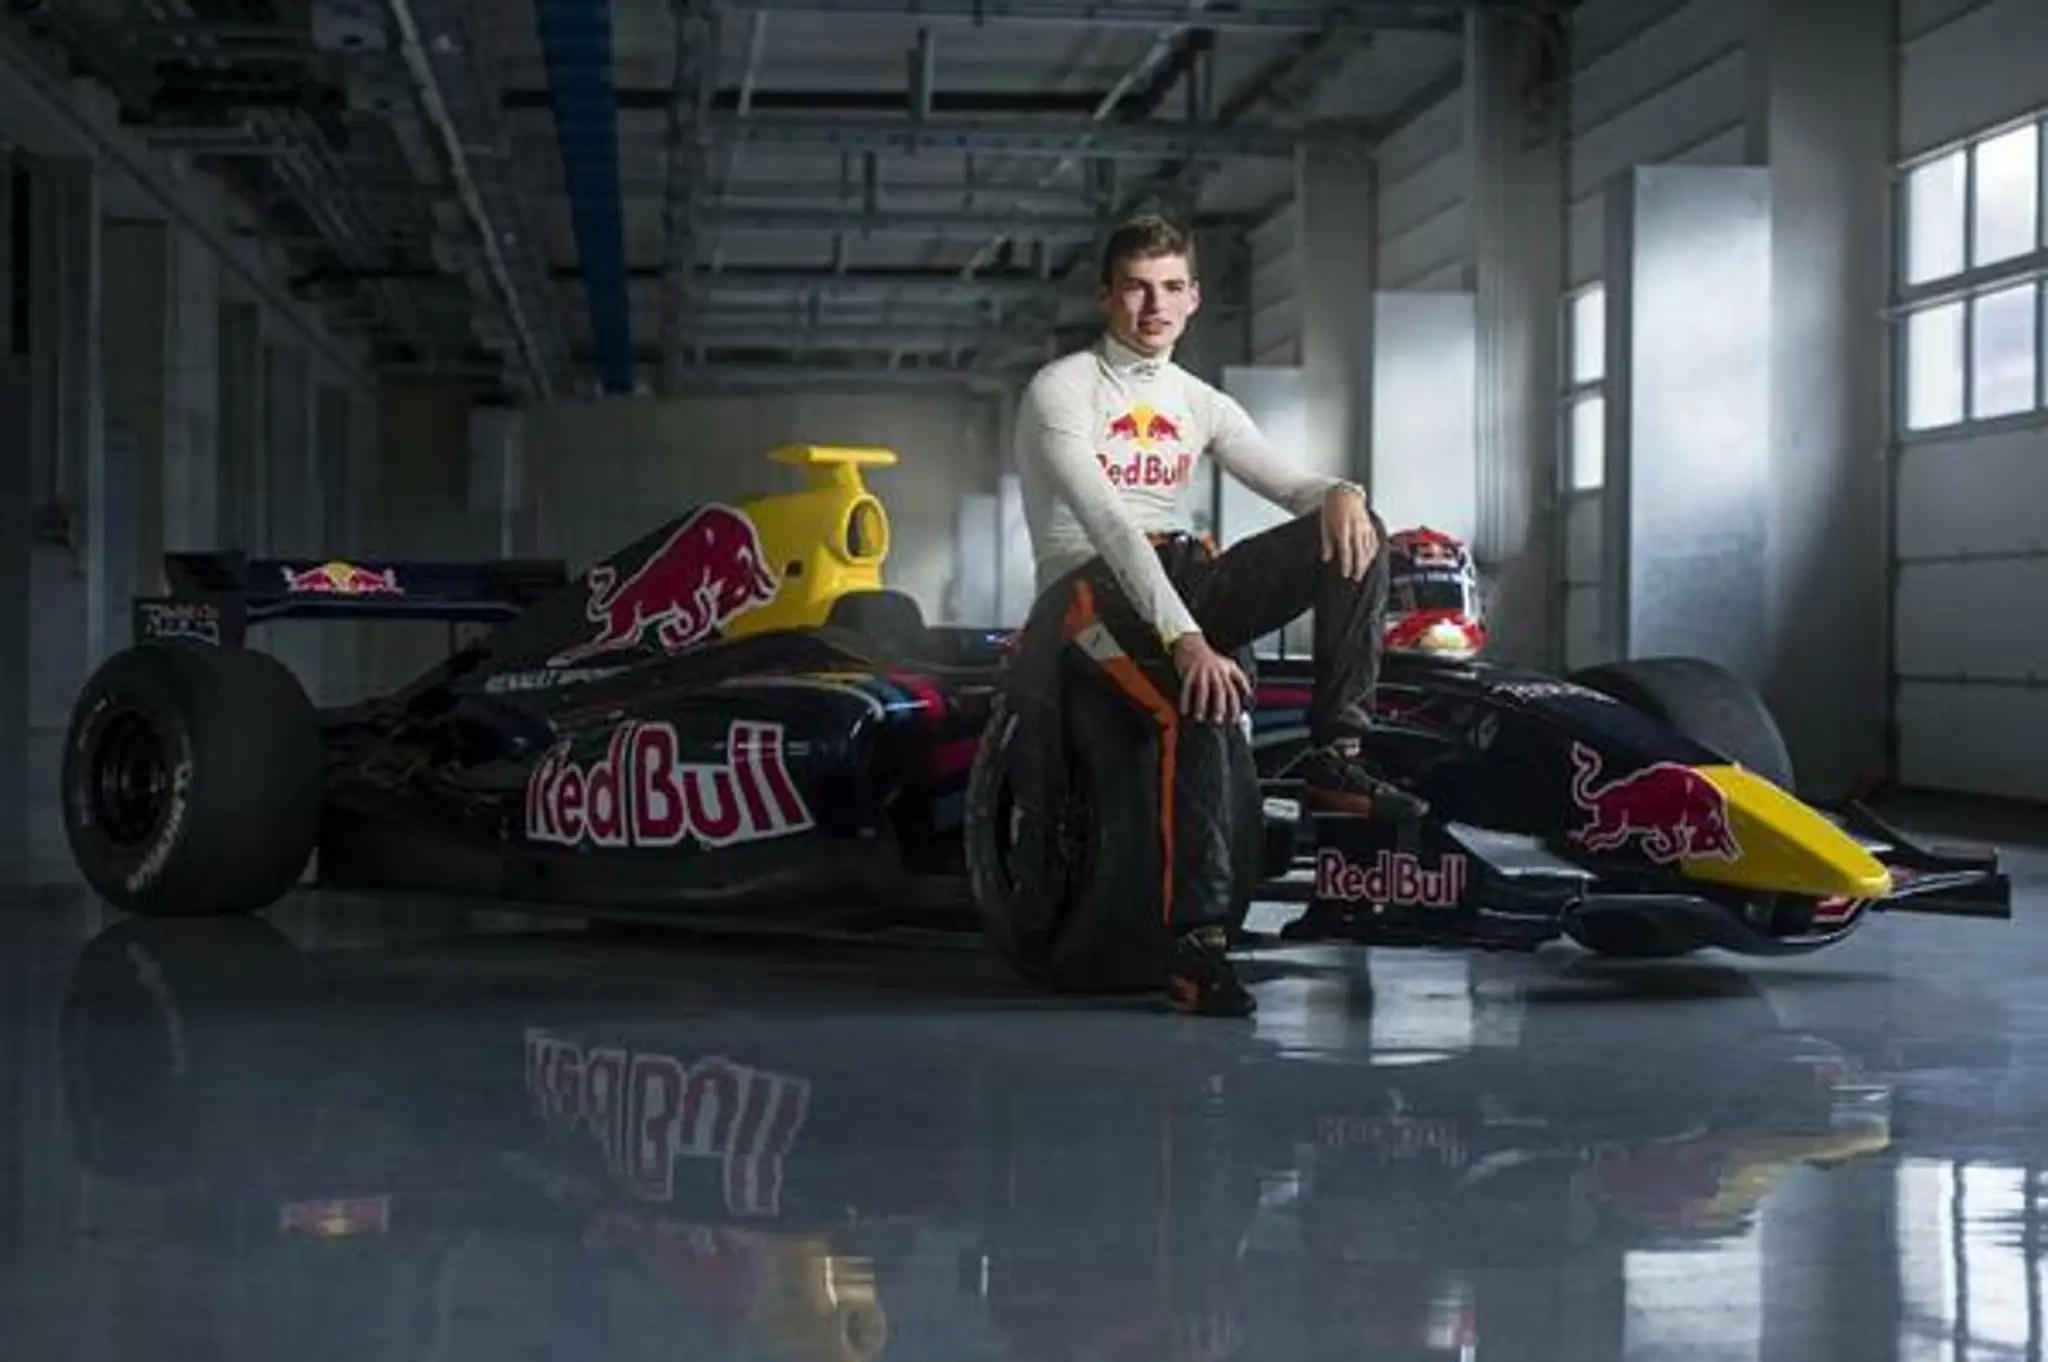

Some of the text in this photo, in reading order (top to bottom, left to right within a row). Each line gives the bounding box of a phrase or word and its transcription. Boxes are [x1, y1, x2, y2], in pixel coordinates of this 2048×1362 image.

[633, 719, 815, 847] Bull
[1317, 849, 1467, 907] Red Bull
